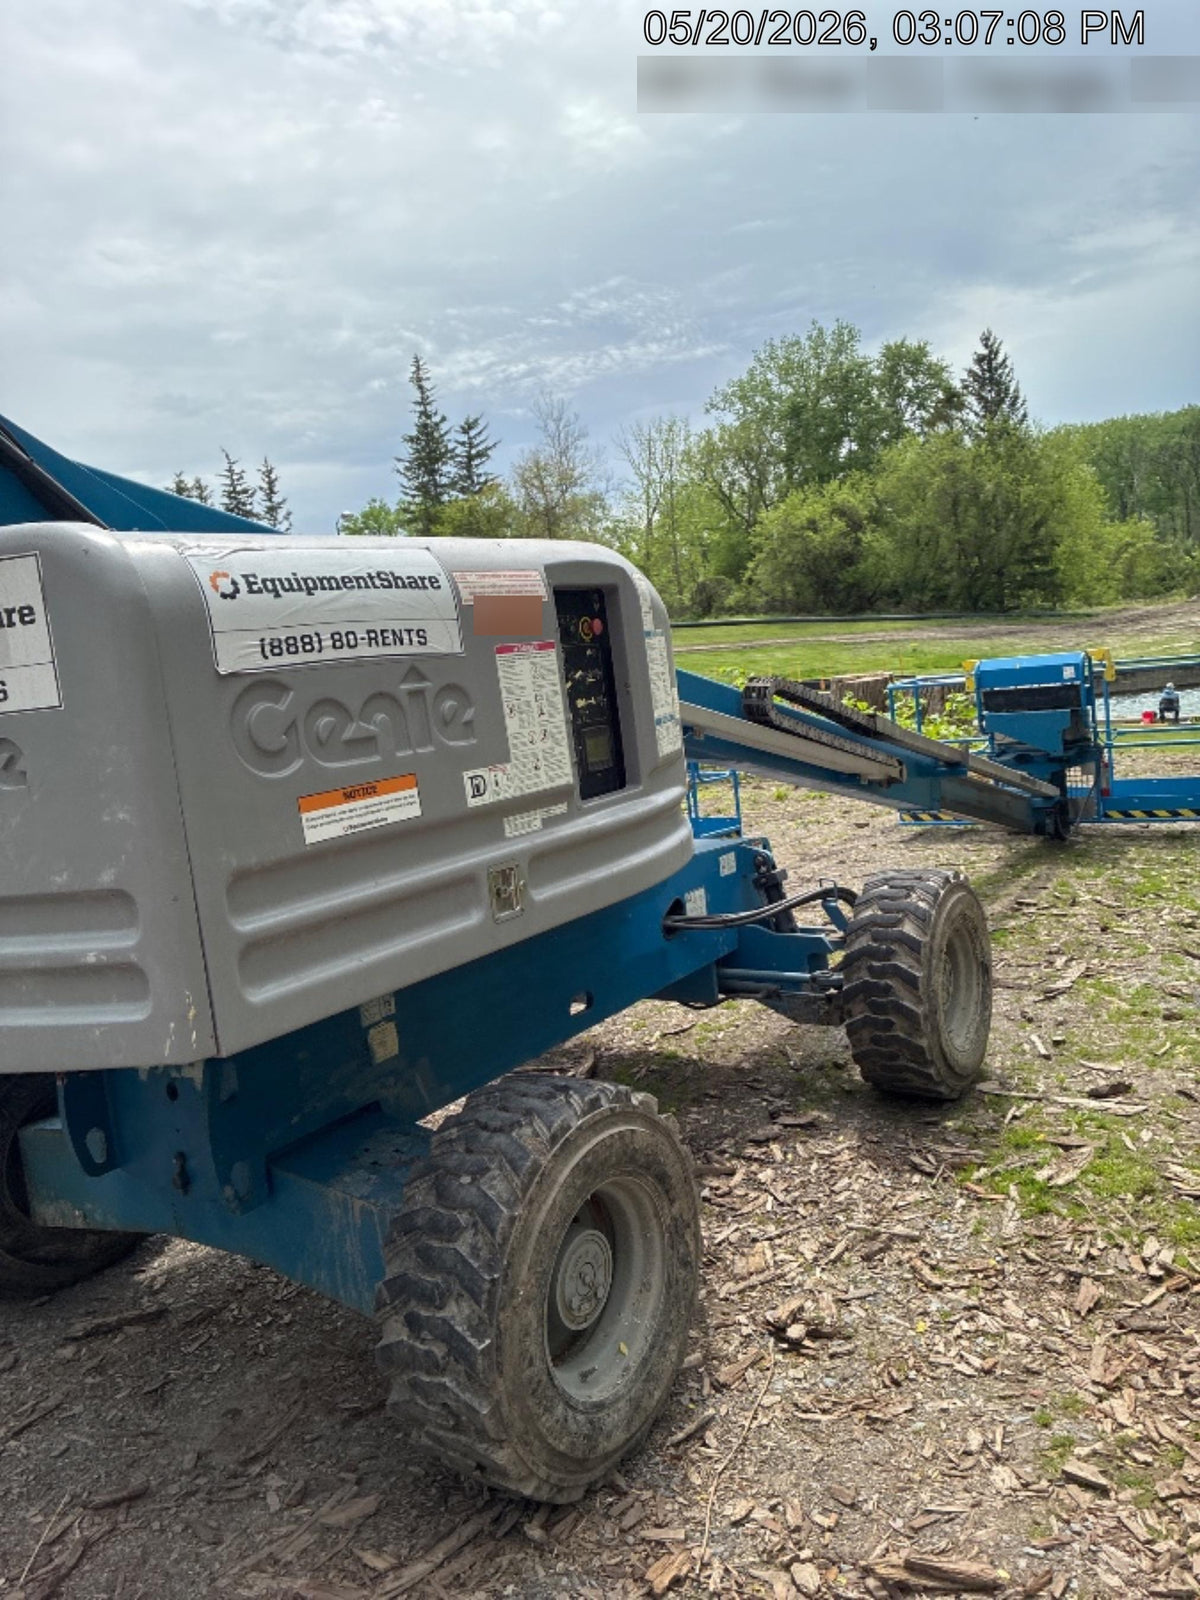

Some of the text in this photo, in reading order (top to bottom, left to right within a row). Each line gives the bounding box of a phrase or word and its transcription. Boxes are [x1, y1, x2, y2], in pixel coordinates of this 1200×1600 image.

[241, 570, 441, 598] EquipmentShare
[260, 629, 427, 659] (888) 80-RENTS
[230, 664, 477, 778] Genie
[342, 785, 378, 801] NOTICE
